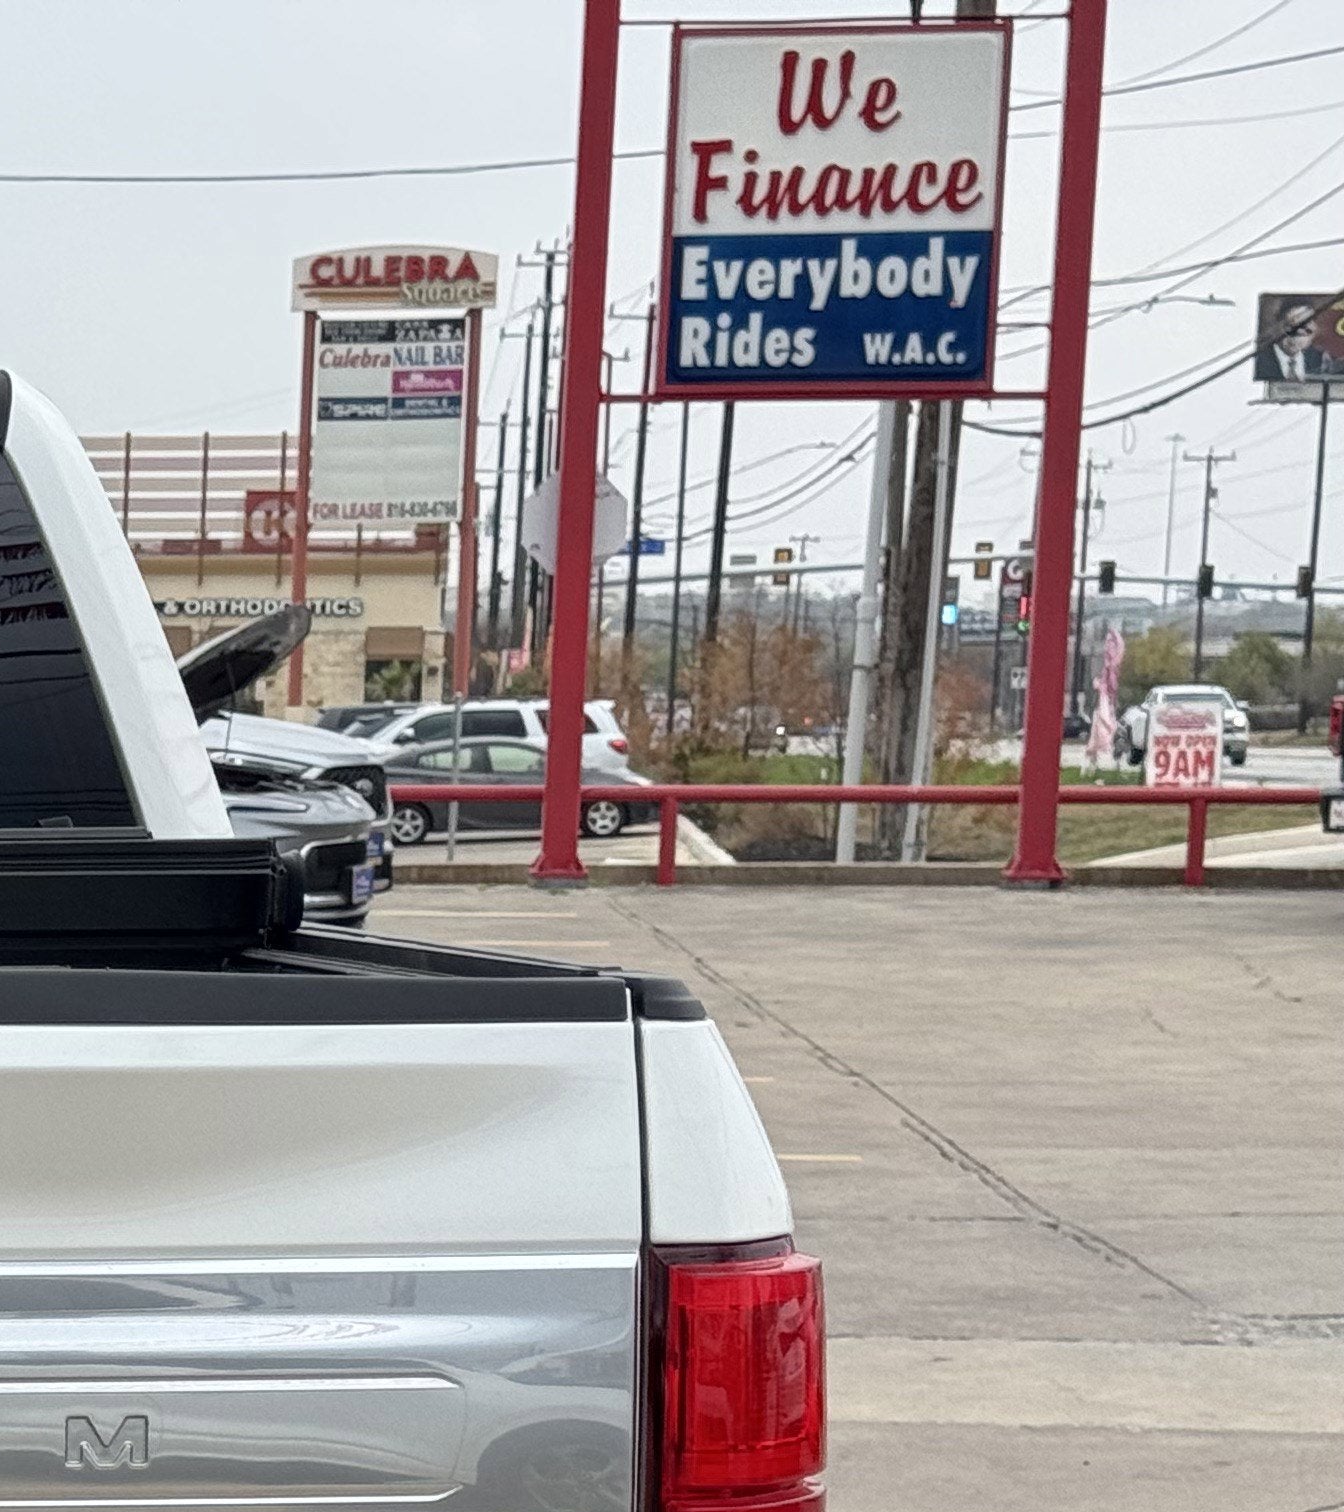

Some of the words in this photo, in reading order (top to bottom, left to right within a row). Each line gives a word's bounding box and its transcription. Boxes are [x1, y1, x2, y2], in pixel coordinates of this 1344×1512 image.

[777, 49, 902, 136] We
[690, 138, 983, 224] Finance
[309, 250, 481, 286] CULEBRA
[680, 236, 980, 312] Everybody
[319, 347, 392, 369] Culebra
[393, 345, 426, 366] NAIL
[678, 311, 818, 369] Rides
[862, 331, 967, 366] W.A.C.
[184, 598, 363, 616] ORTHODTICS
[1154, 750, 1215, 778] 9AM
